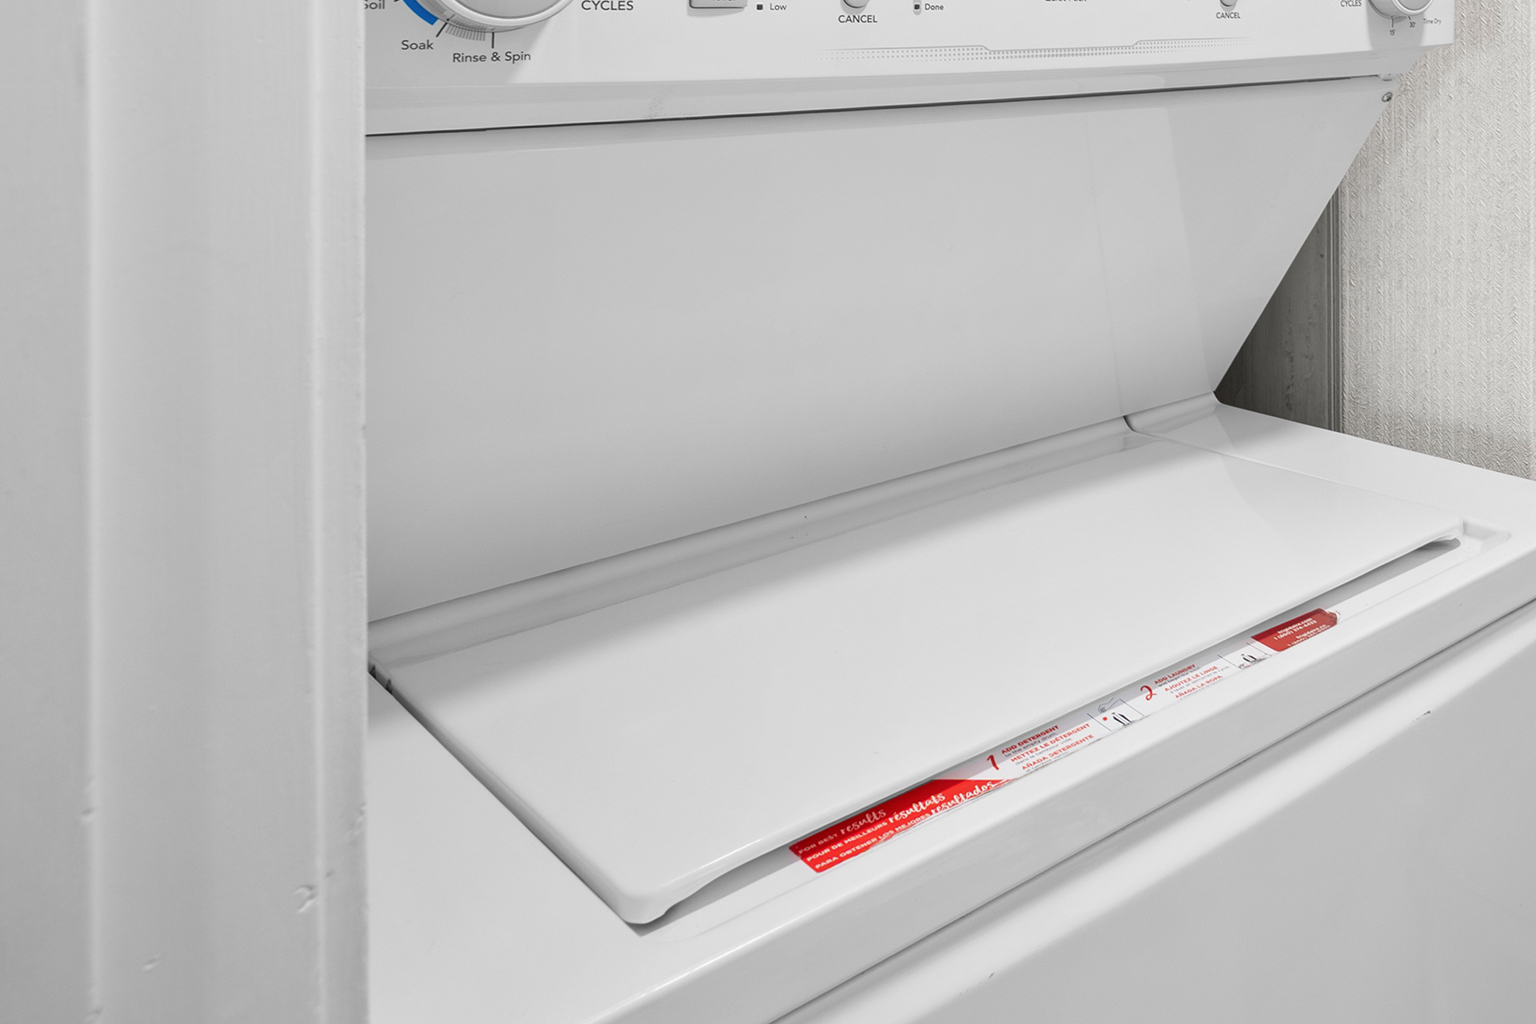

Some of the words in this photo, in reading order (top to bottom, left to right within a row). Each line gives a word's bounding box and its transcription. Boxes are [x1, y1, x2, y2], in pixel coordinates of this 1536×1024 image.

[581, 0, 634, 11] CYCLES
[1340, 0, 1362, 8] CYCLES
[838, 15, 878, 23] CANCEL
[401, 40, 434, 50] Soak
[453, 52, 487, 63] Rinse
[491, 53, 501, 62] &
[505, 51, 531, 63] Spin
[1140, 685, 1157, 701] 2
[1001, 744, 1017, 755] ADD
[1018, 725, 1059, 747] DETERGENT
[1011, 748, 1040, 763] METTEZ
[1050, 723, 1090, 746] DÉTERGENT
[987, 754, 1000, 771] 1
[799, 843, 816, 854] FOR
[818, 834, 838, 845] BEST
[840, 809, 887, 835] results
[806, 849, 831, 862] POUR
[831, 843, 843, 851] DE
[844, 822, 888, 845] MEILLEURS
[888, 792, 946, 824] résultats
[815, 857, 838, 869] PARA
[839, 838, 877, 857] OBTENER
[930, 781, 994, 816] resultados
